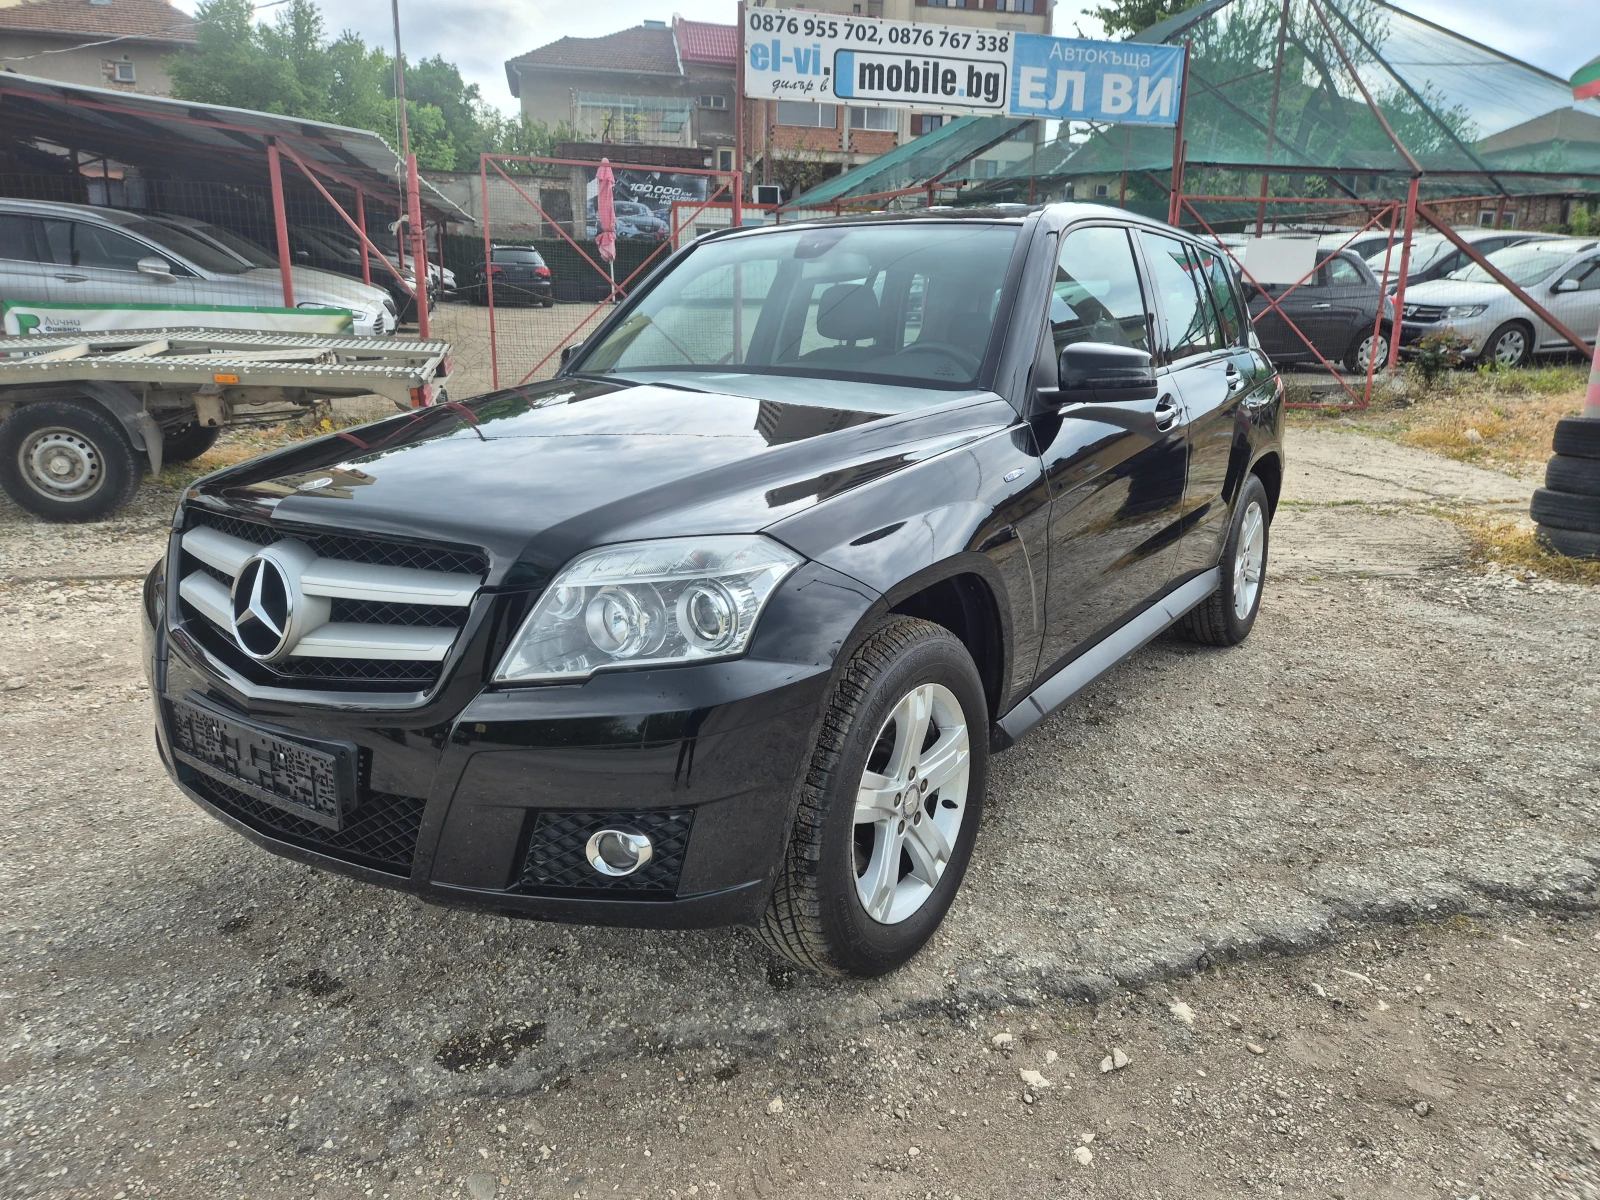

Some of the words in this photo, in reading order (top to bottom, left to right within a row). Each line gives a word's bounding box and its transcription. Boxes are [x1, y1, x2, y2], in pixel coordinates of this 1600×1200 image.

[750, 13, 799, 35] 0876
[803, 18, 838, 39] 955
[844, 22, 883, 45] 702,
[888, 26, 934, 46] 0876
[939, 30, 971, 50] 767
[976, 34, 1009, 53] 338
[1049, 41, 1151, 71] Автокъща
[859, 59, 1000, 103] mobile.bg
[1018, 65, 1086, 112] ЕЛ
[1100, 72, 1173, 117] ВИ
[630, 183, 653, 192] 100
[654, 185, 682, 195] 000
[45, 316, 81, 326] Лични
